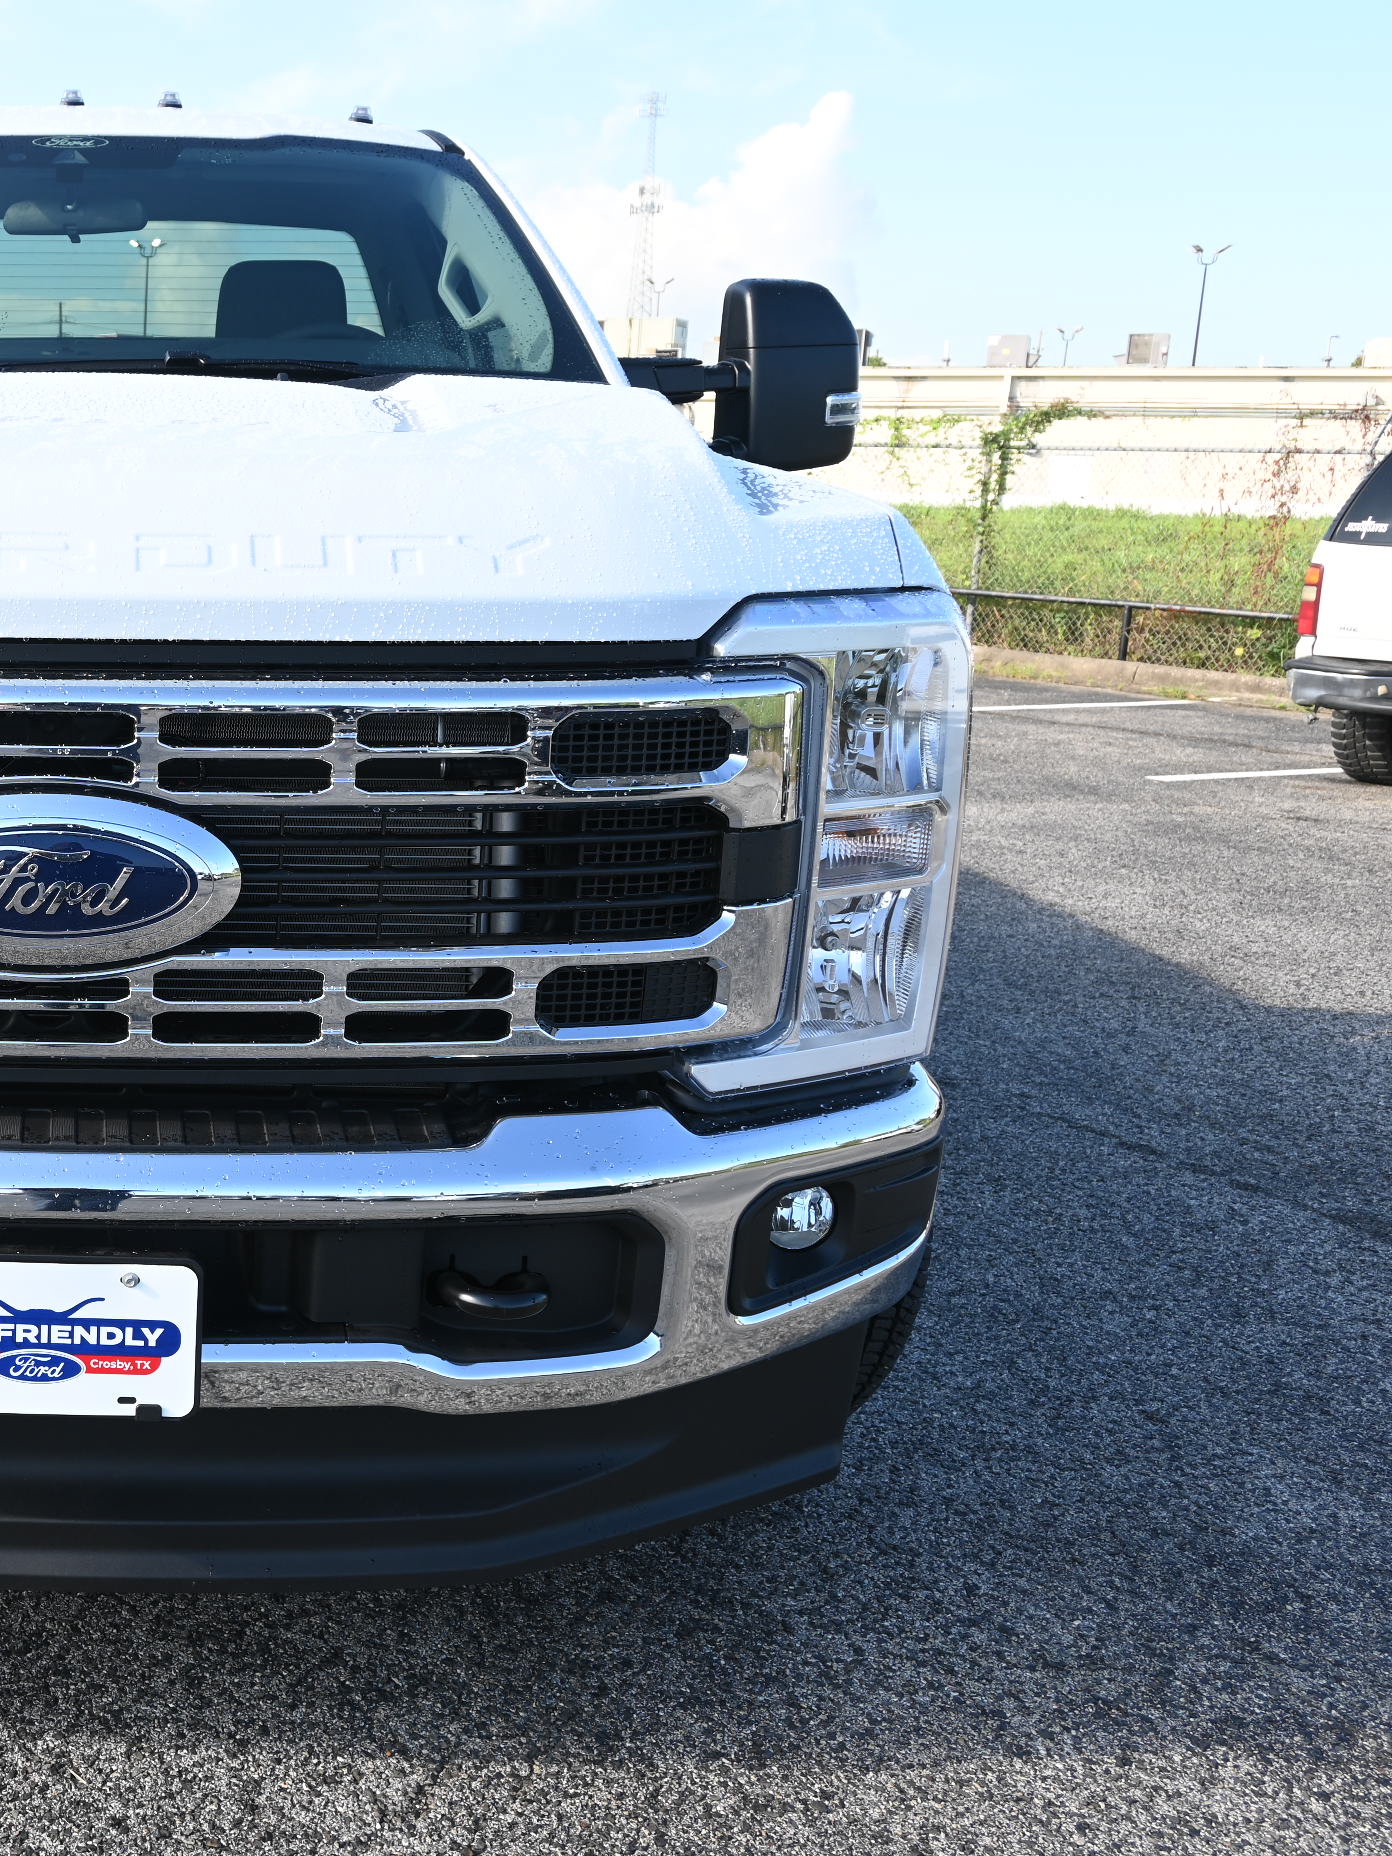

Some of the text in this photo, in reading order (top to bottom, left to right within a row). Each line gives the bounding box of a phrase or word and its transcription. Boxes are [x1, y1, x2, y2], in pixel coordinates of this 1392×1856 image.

[46, 138, 95, 146] Ford
[131, 530, 552, 576] DUTY
[10, 1355, 63, 1378] Ford
[90, 1359, 151, 1370] Crosby, TX
